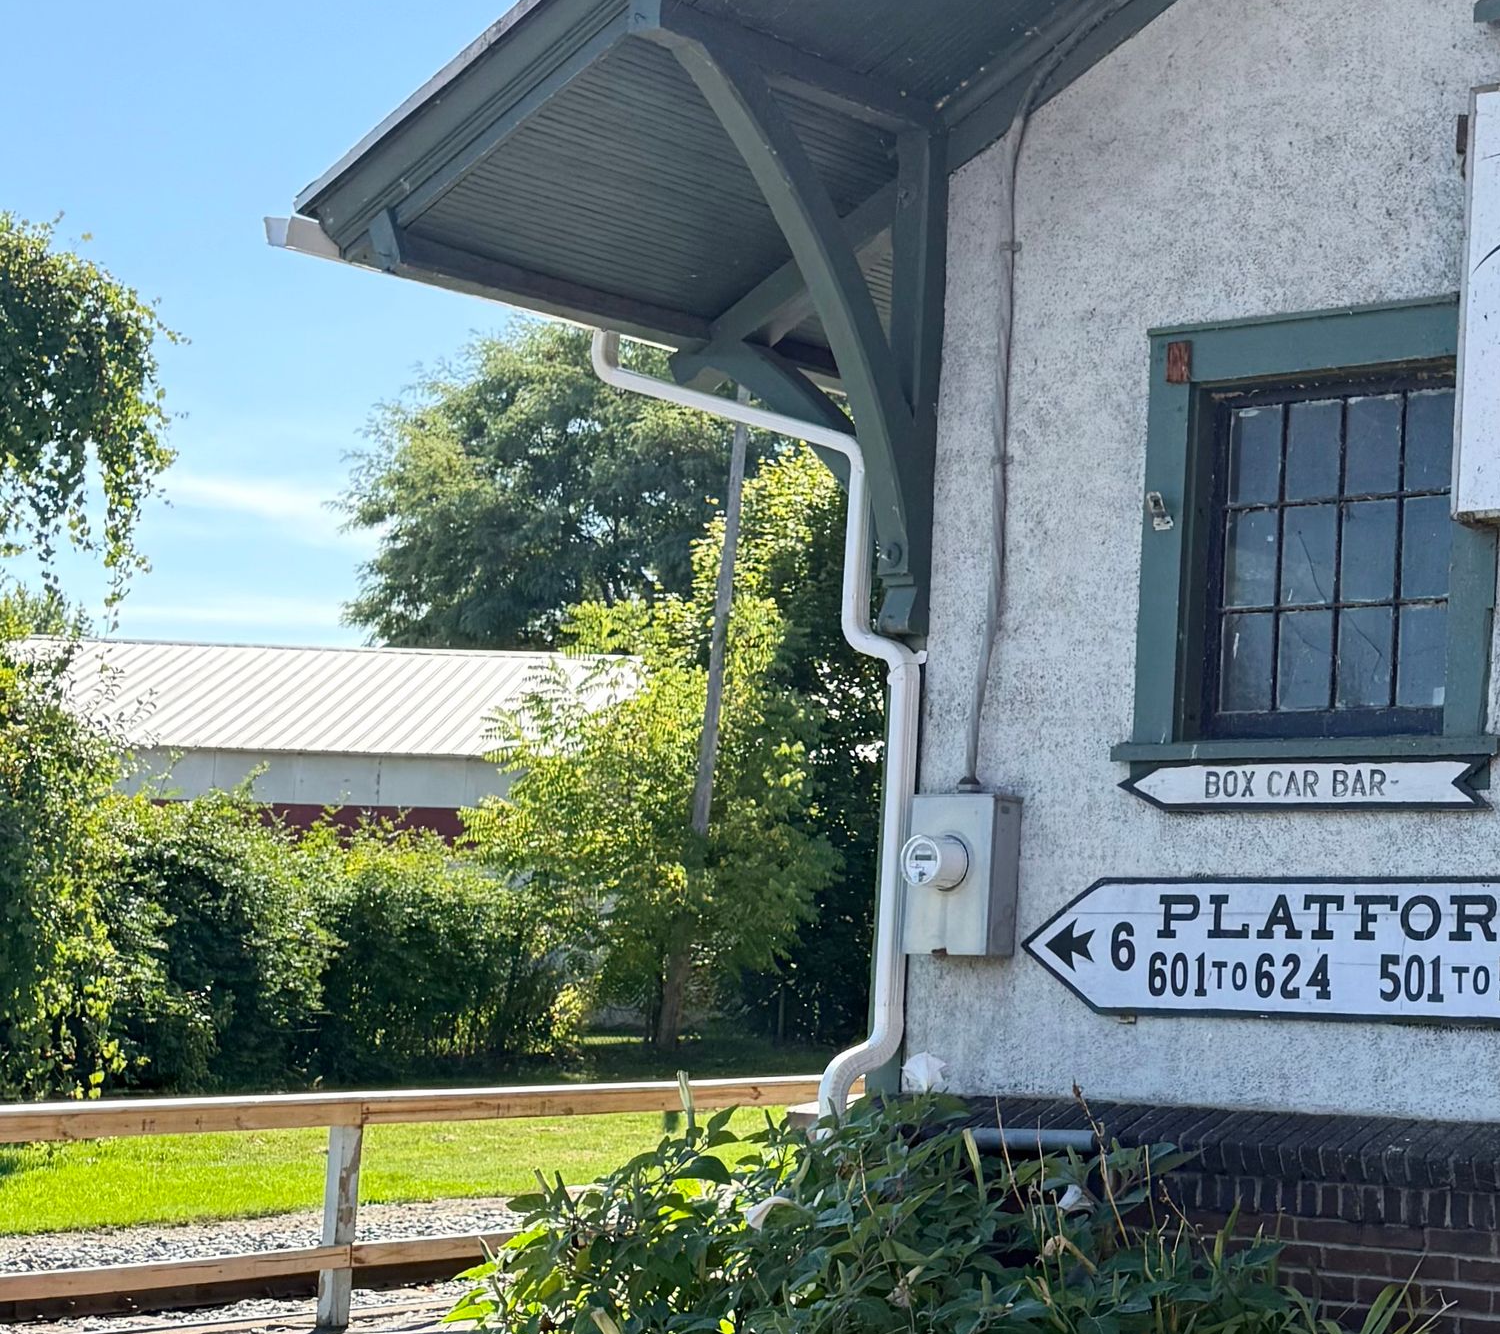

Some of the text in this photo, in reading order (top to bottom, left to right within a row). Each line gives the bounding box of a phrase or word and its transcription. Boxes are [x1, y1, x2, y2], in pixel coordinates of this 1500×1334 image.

[1204, 769, 1256, 799] BOX
[1266, 769, 1320, 799] CAR
[1109, 921, 1136, 972] 6
[1147, 952, 1208, 998] 601
[1253, 952, 1333, 1001] 624
[1379, 954, 1446, 1003] 501
